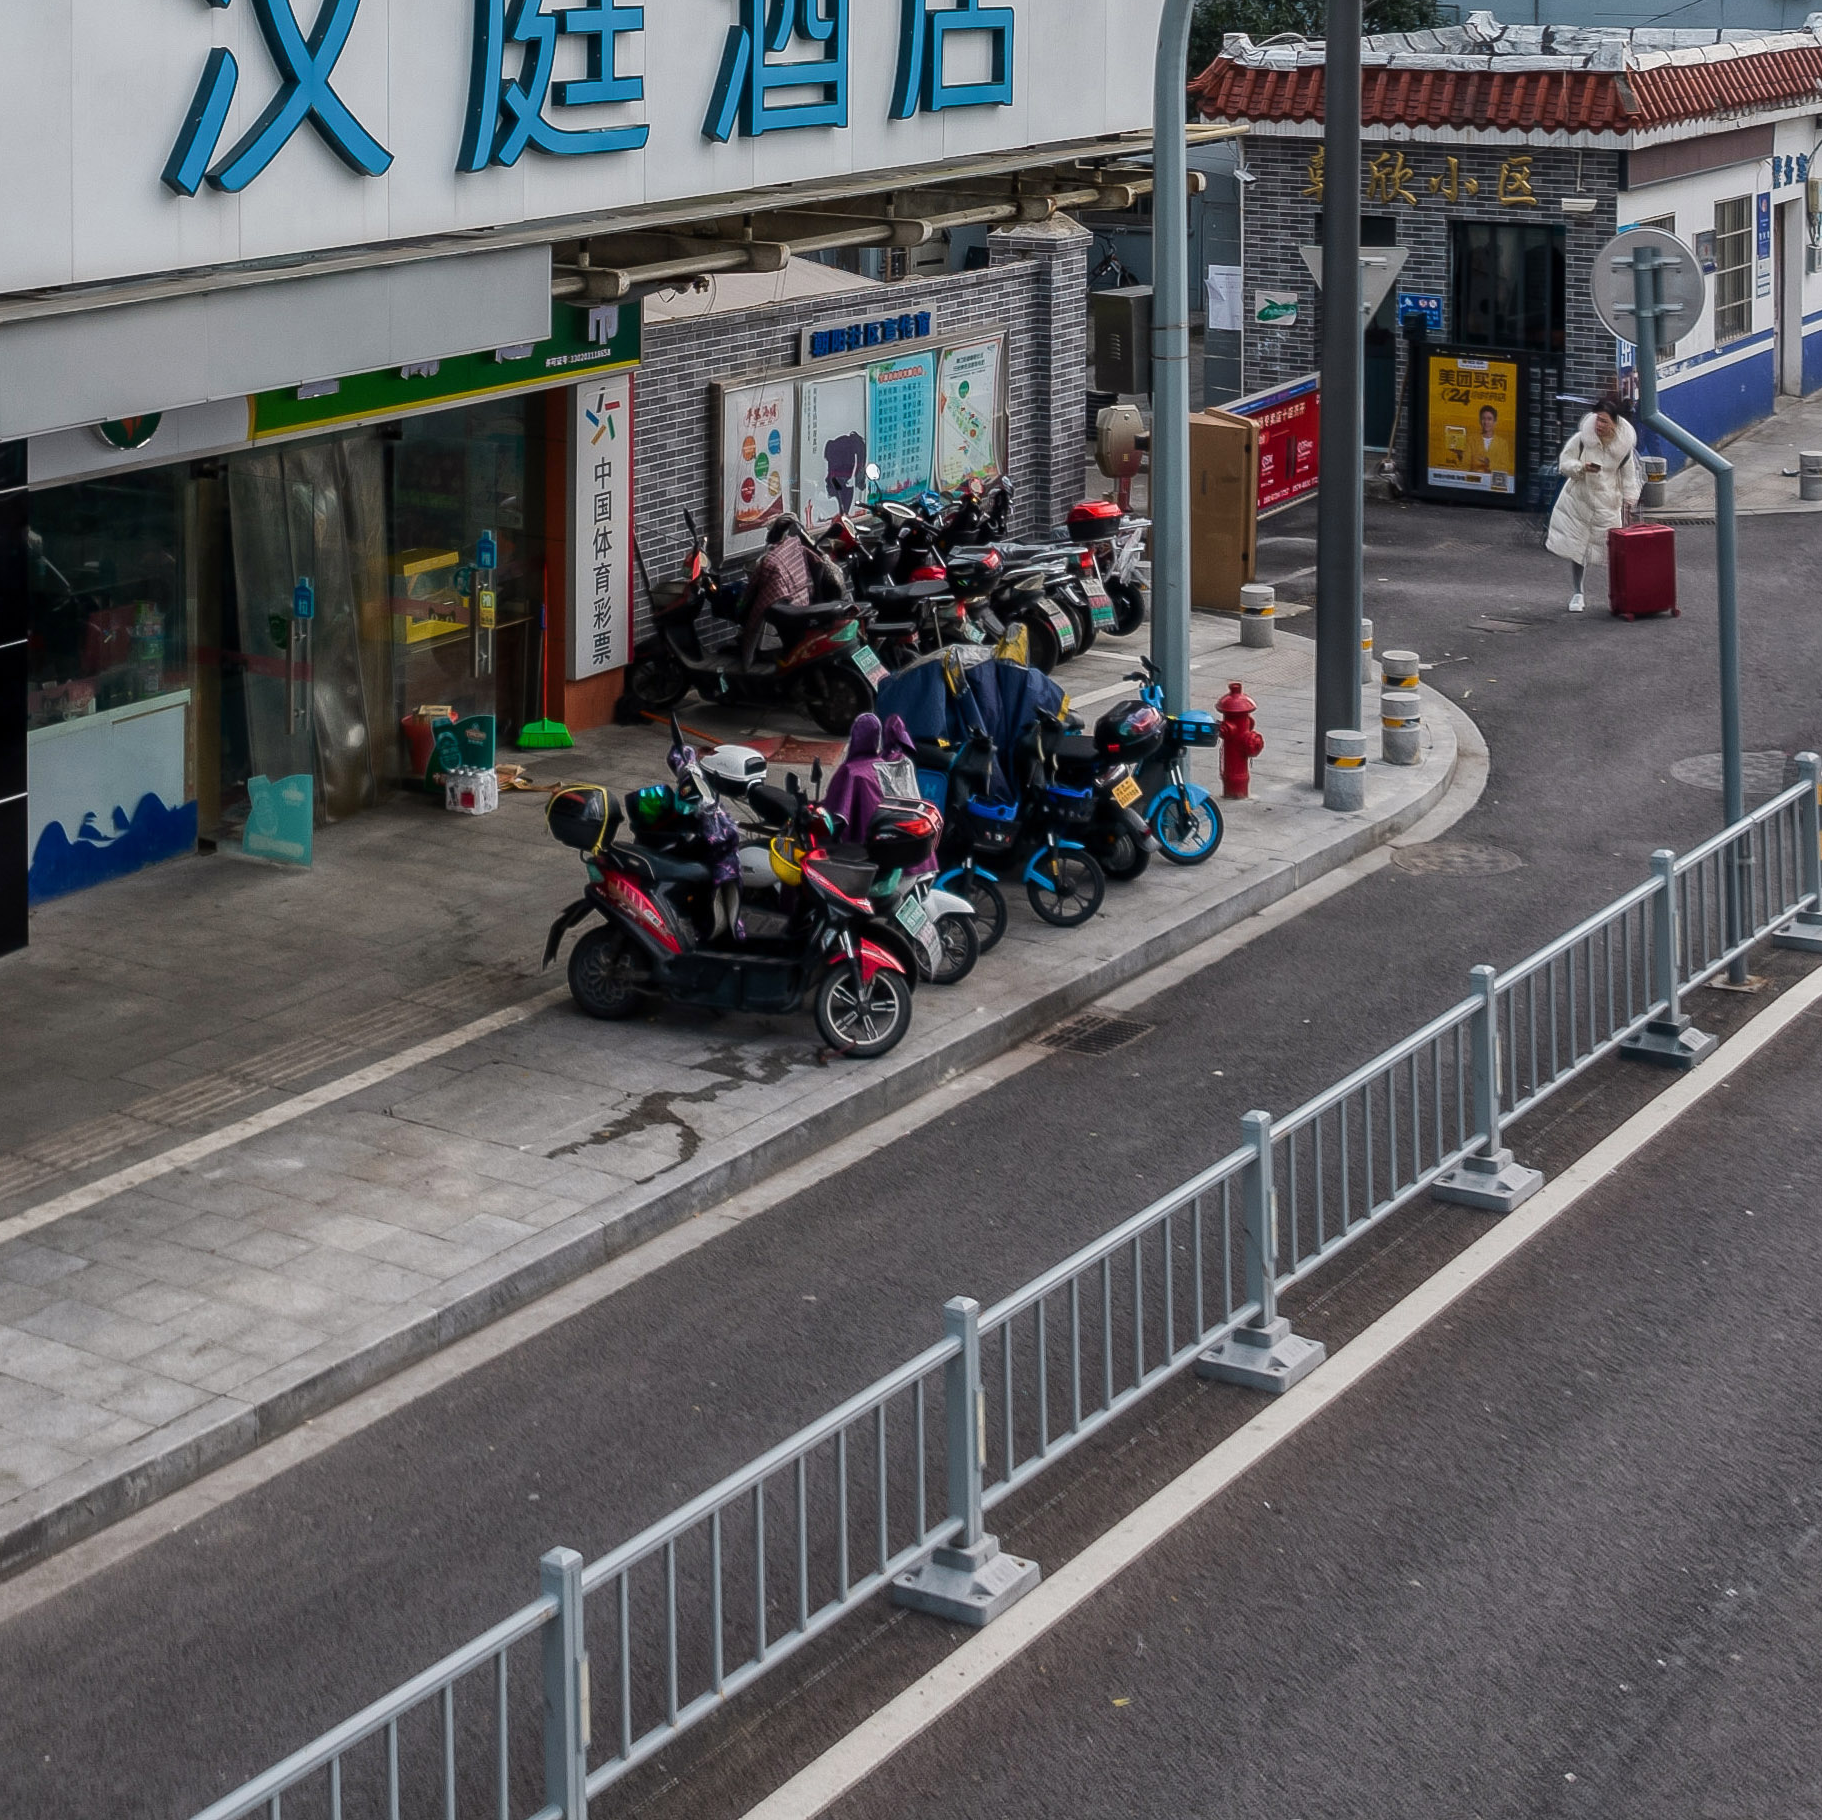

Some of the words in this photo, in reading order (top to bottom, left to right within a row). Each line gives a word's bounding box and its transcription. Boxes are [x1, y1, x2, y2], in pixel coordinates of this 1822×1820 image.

[1439, 368, 1508, 392] 美团买药
[591, 456, 613, 666] 中国体育彩票
